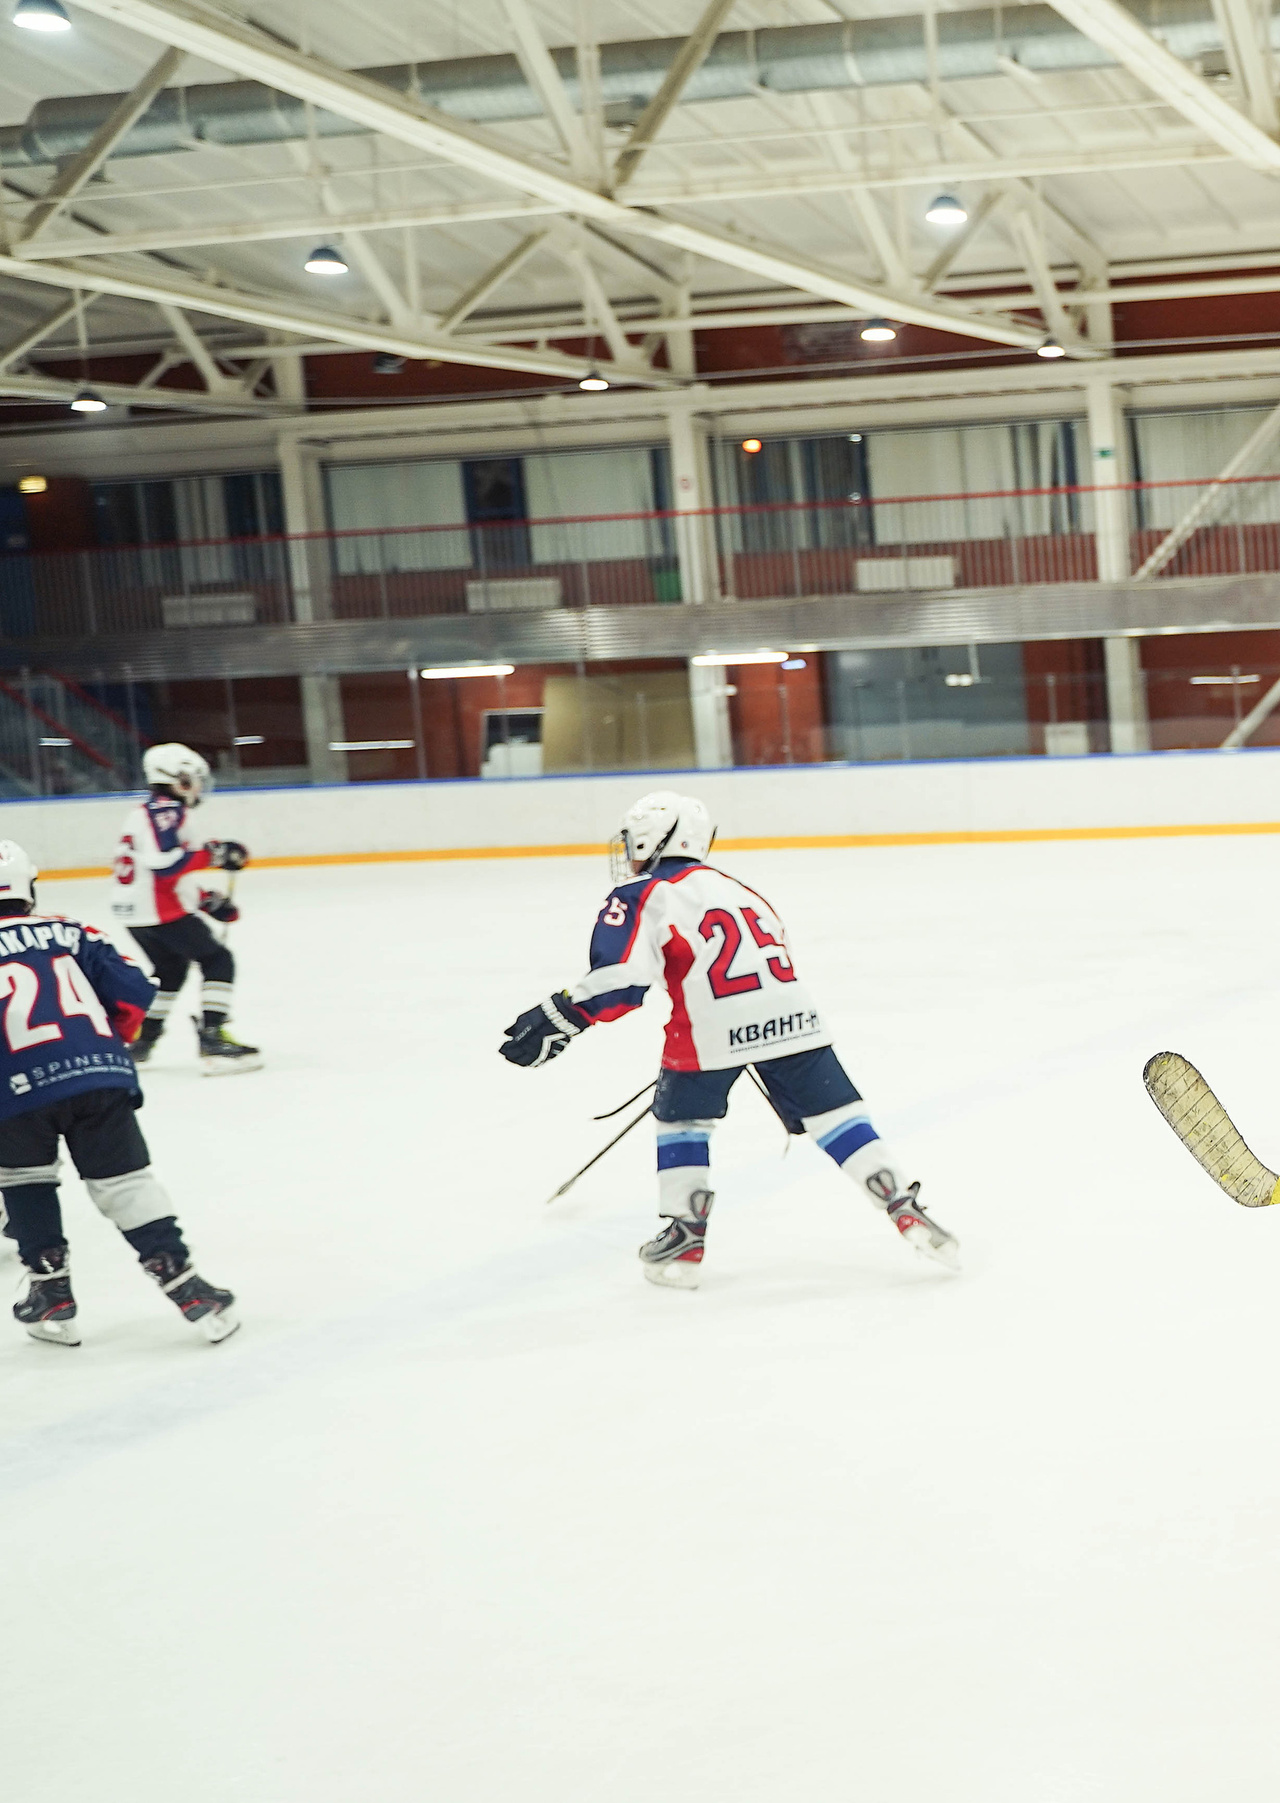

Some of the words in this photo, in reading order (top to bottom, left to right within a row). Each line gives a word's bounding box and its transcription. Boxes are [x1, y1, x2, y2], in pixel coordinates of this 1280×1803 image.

[599, 896, 628, 927] 5
[698, 907, 797, 999] 25
[0, 953, 113, 1053] 24
